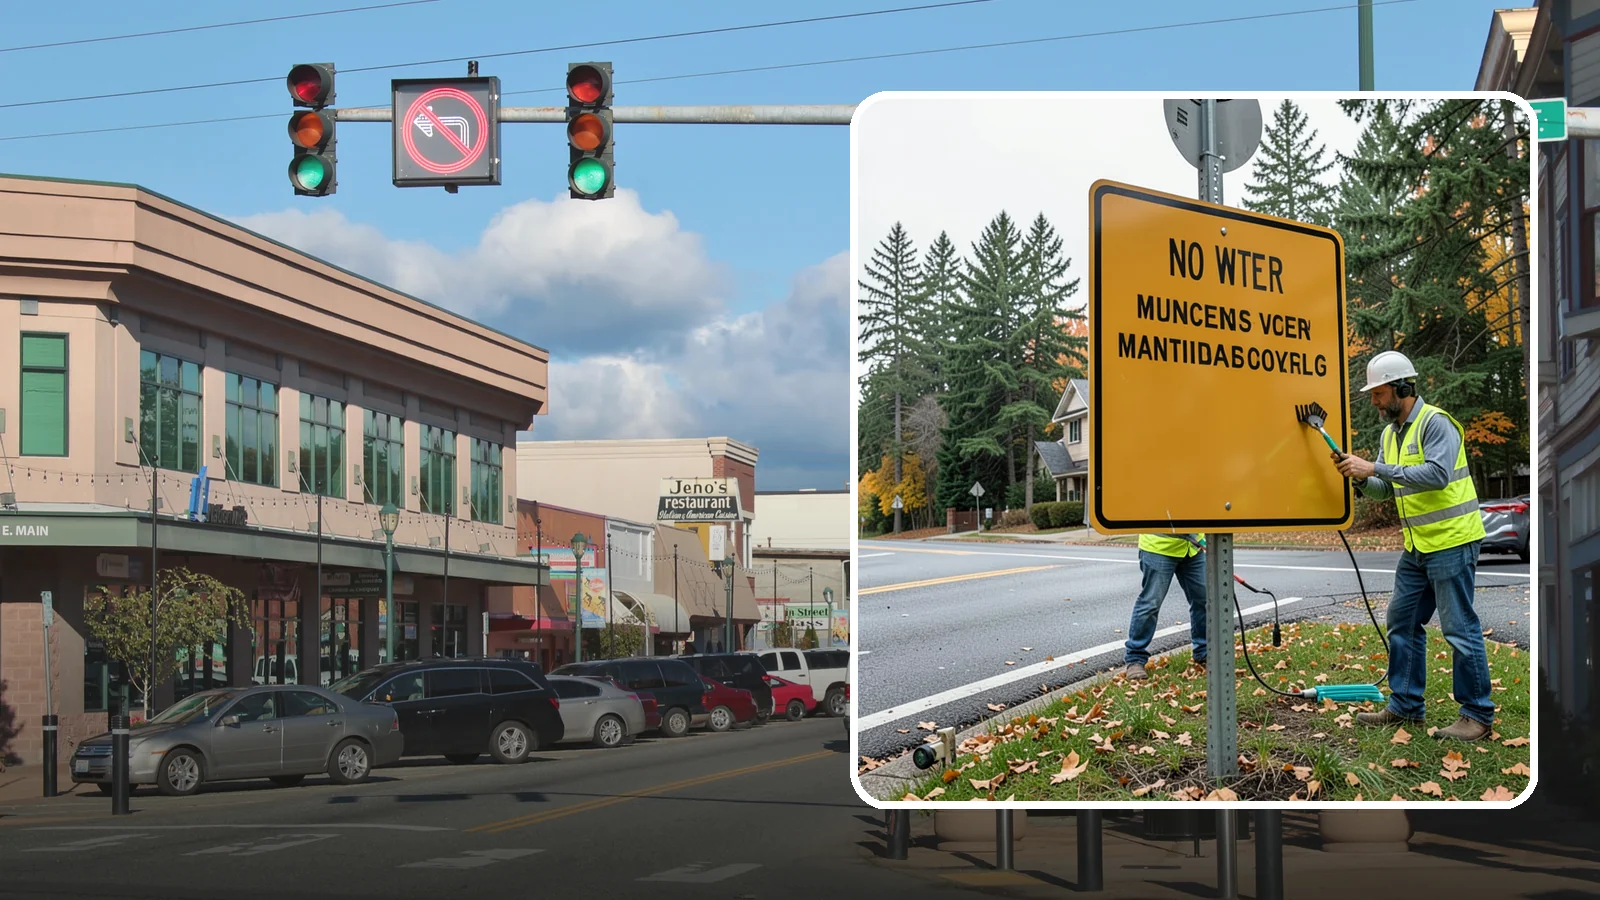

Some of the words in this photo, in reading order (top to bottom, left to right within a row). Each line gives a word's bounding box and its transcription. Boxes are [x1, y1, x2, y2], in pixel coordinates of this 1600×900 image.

[1169, 238, 1204, 281] NO
[1215, 245, 1284, 294] WTER
[1137, 294, 1251, 333] MUNCENS
[670, 480, 727, 495] Jeno's
[665, 496, 731, 509] restaurant
[659, 510, 681, 519] Italian
[686, 510, 714, 519] American
[715, 510, 738, 519] Cuisine
[2, 525, 13, 536] E.
[15, 525, 49, 536] MAIN
[797, 607, 829, 617] Street
